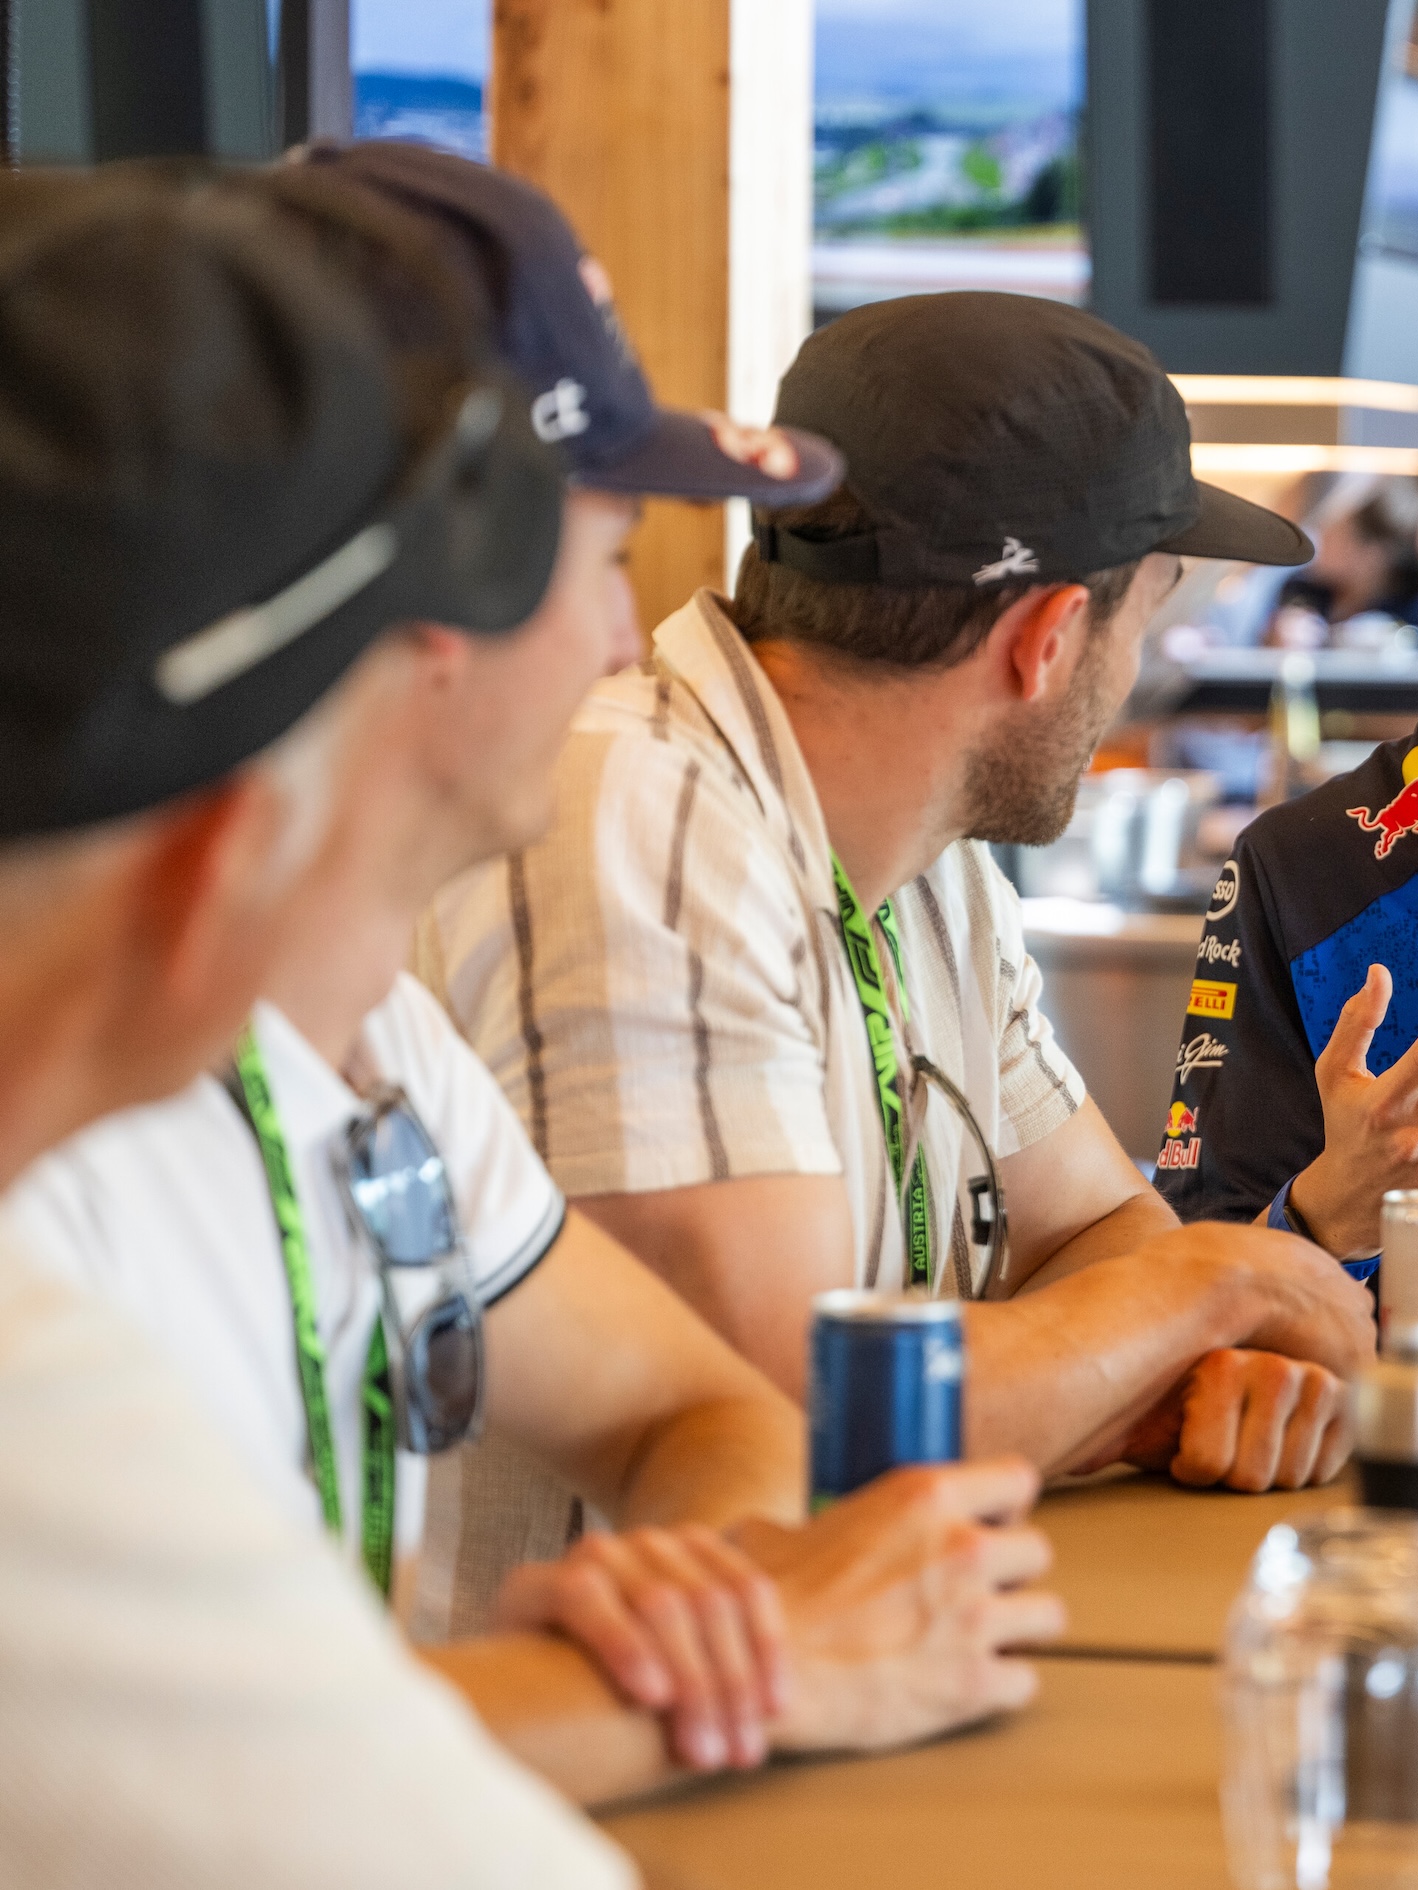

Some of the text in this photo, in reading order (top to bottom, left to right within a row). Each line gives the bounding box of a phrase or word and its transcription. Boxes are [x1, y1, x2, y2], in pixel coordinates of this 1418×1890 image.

[1205, 935, 1242, 968] Rock
[1188, 995, 1226, 1011] ELLI
[1168, 1137, 1202, 1170] Bull
[913, 1186, 927, 1271] AUSTRIA
